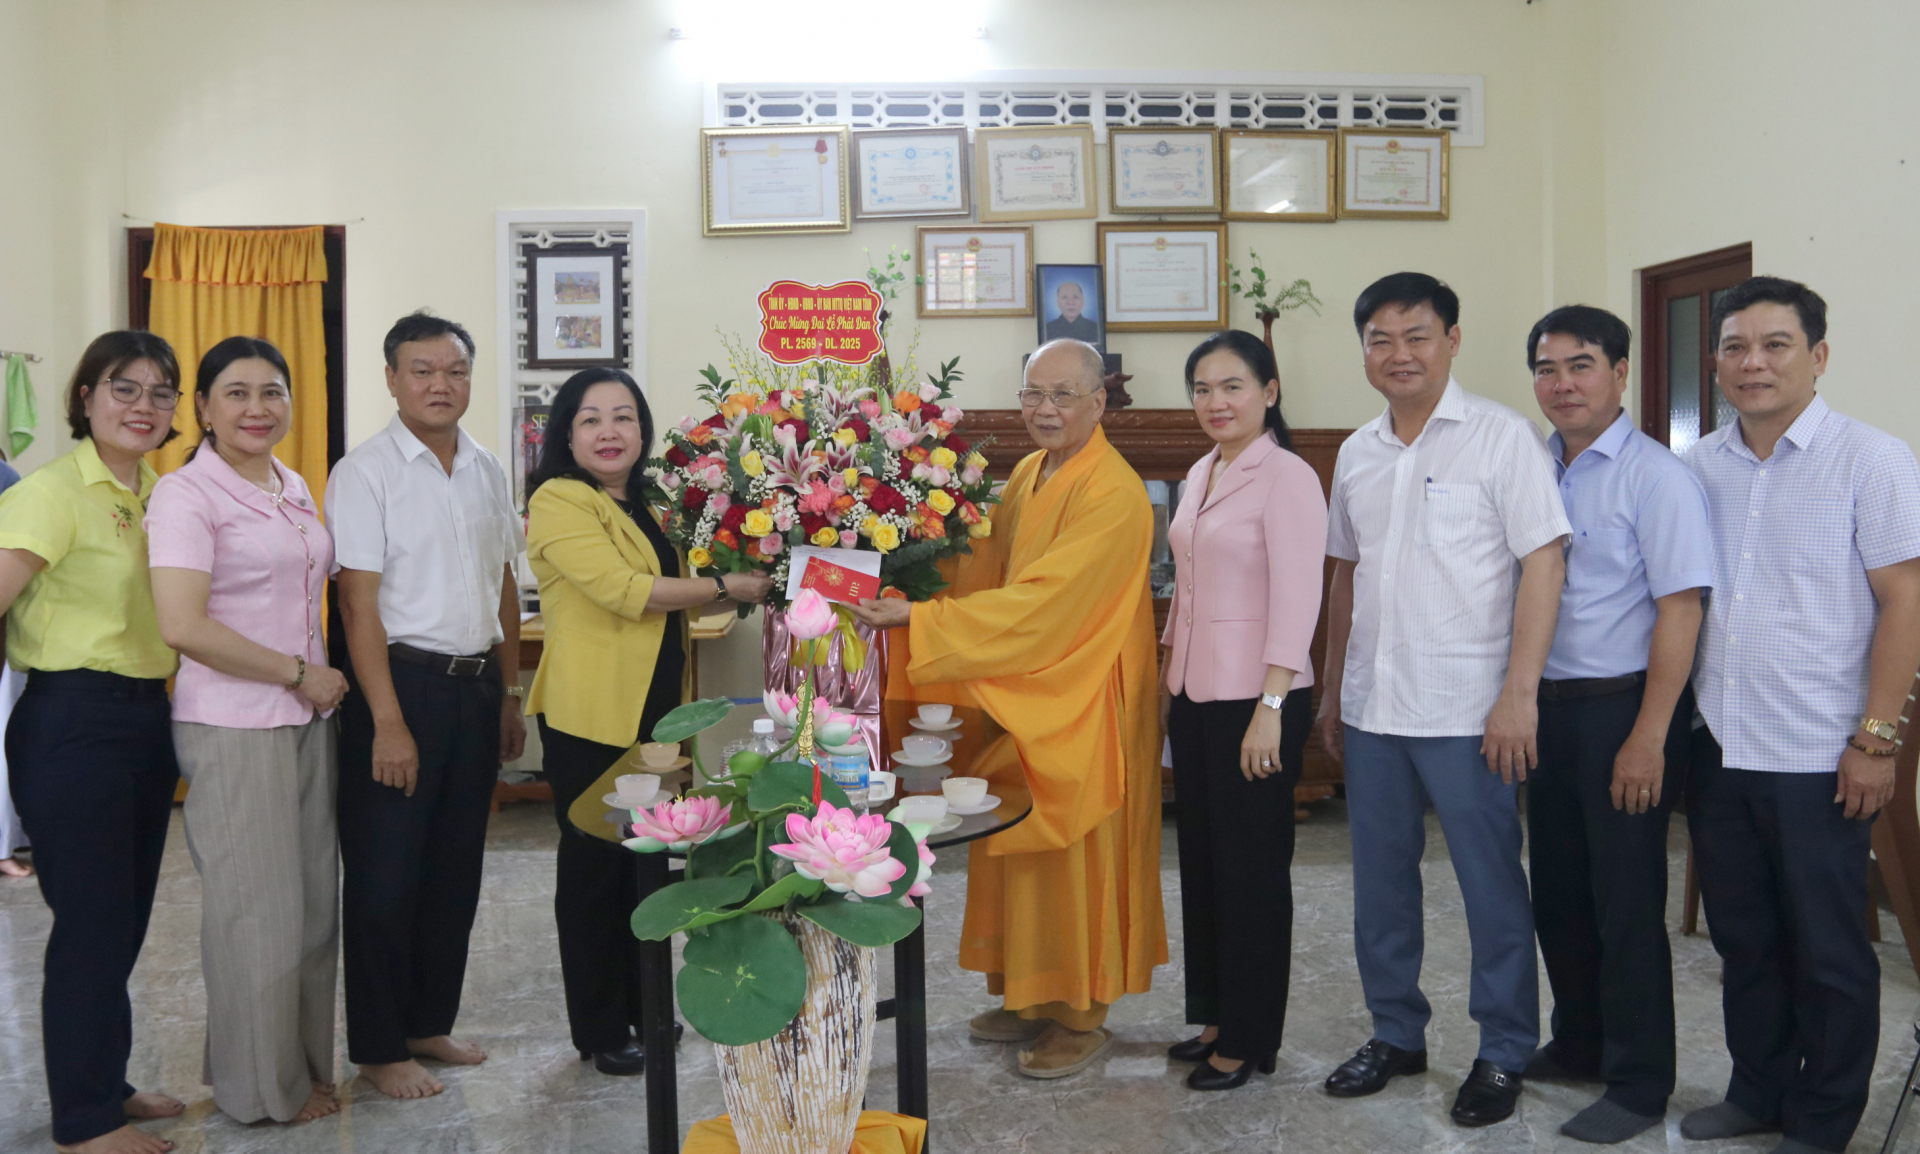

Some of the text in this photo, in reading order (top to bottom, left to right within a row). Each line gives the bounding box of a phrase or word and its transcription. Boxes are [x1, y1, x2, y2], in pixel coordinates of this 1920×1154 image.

[769, 314, 871, 335] Chúc Mừng Đại Lễ Phật Đản
[780, 337, 794, 349] PL.
[795, 337, 817, 349] 2569
[825, 337, 838, 349] DL.
[839, 337, 861, 349] 2025
